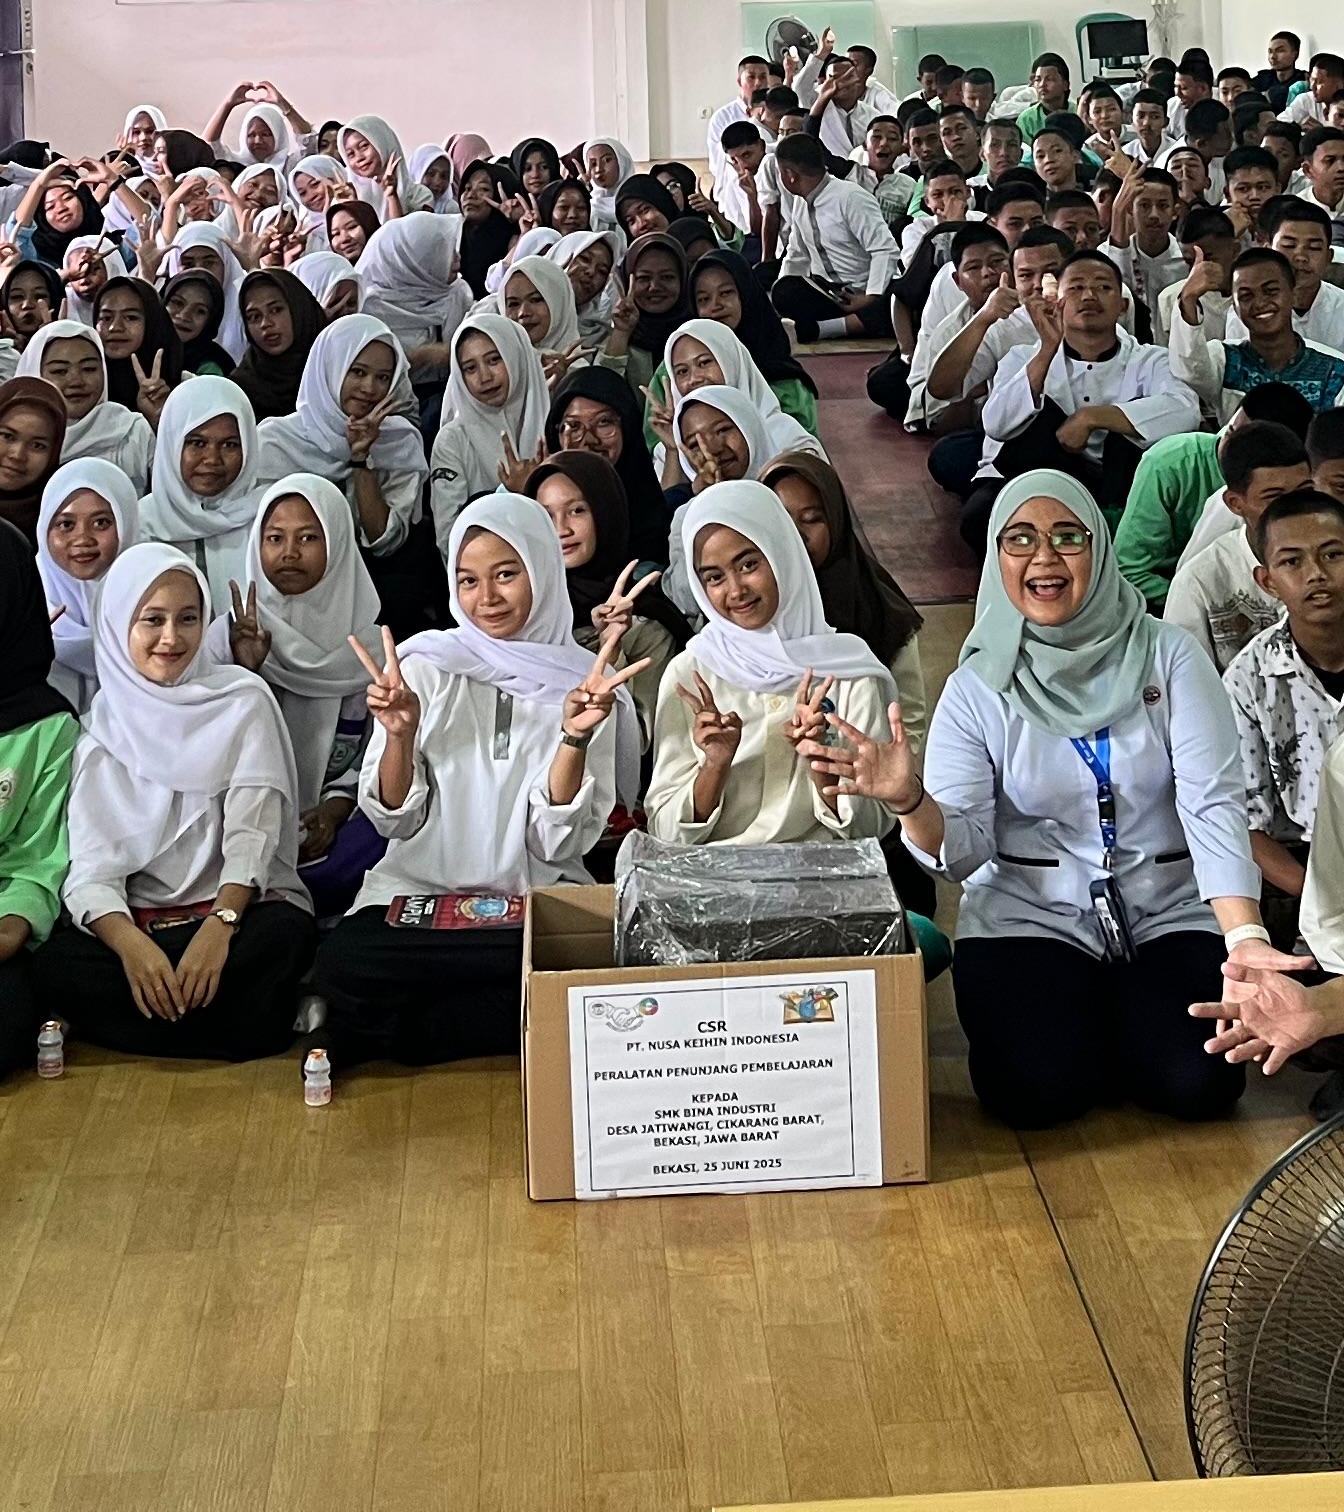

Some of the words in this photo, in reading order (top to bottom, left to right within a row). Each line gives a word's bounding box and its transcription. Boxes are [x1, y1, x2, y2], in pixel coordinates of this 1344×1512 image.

[697, 1020, 728, 1034] CSR
[626, 1041, 645, 1052] PT.
[648, 1039, 681, 1051] NUSA
[683, 1036, 728, 1049] KEIHIN
[731, 1032, 800, 1046] INDONESIA
[594, 1068, 663, 1081] PERALATAN
[666, 1063, 738, 1078] PENUNJANG
[741, 1058, 833, 1073] PEMBELAJARAN
[691, 1091, 739, 1104] KEPADA
[654, 1109, 681, 1120] SMK
[683, 1107, 714, 1118] BINA
[716, 1102, 776, 1115] INDUSTRI
[607, 1125, 638, 1136] DESA
[640, 1118, 714, 1134] JATIWANGI,
[716, 1116, 780, 1130] CIKARANG
[782, 1114, 824, 1126] BARAT,
[653, 1135, 701, 1148] BEKASI,
[703, 1132, 738, 1145] JAWA
[740, 1130, 780, 1142] BARAT
[653, 1163, 700, 1175] BEKASI,
[703, 1161, 718, 1172] 25
[721, 1160, 750, 1171] JUNI
[753, 1158, 782, 1169] 2025
